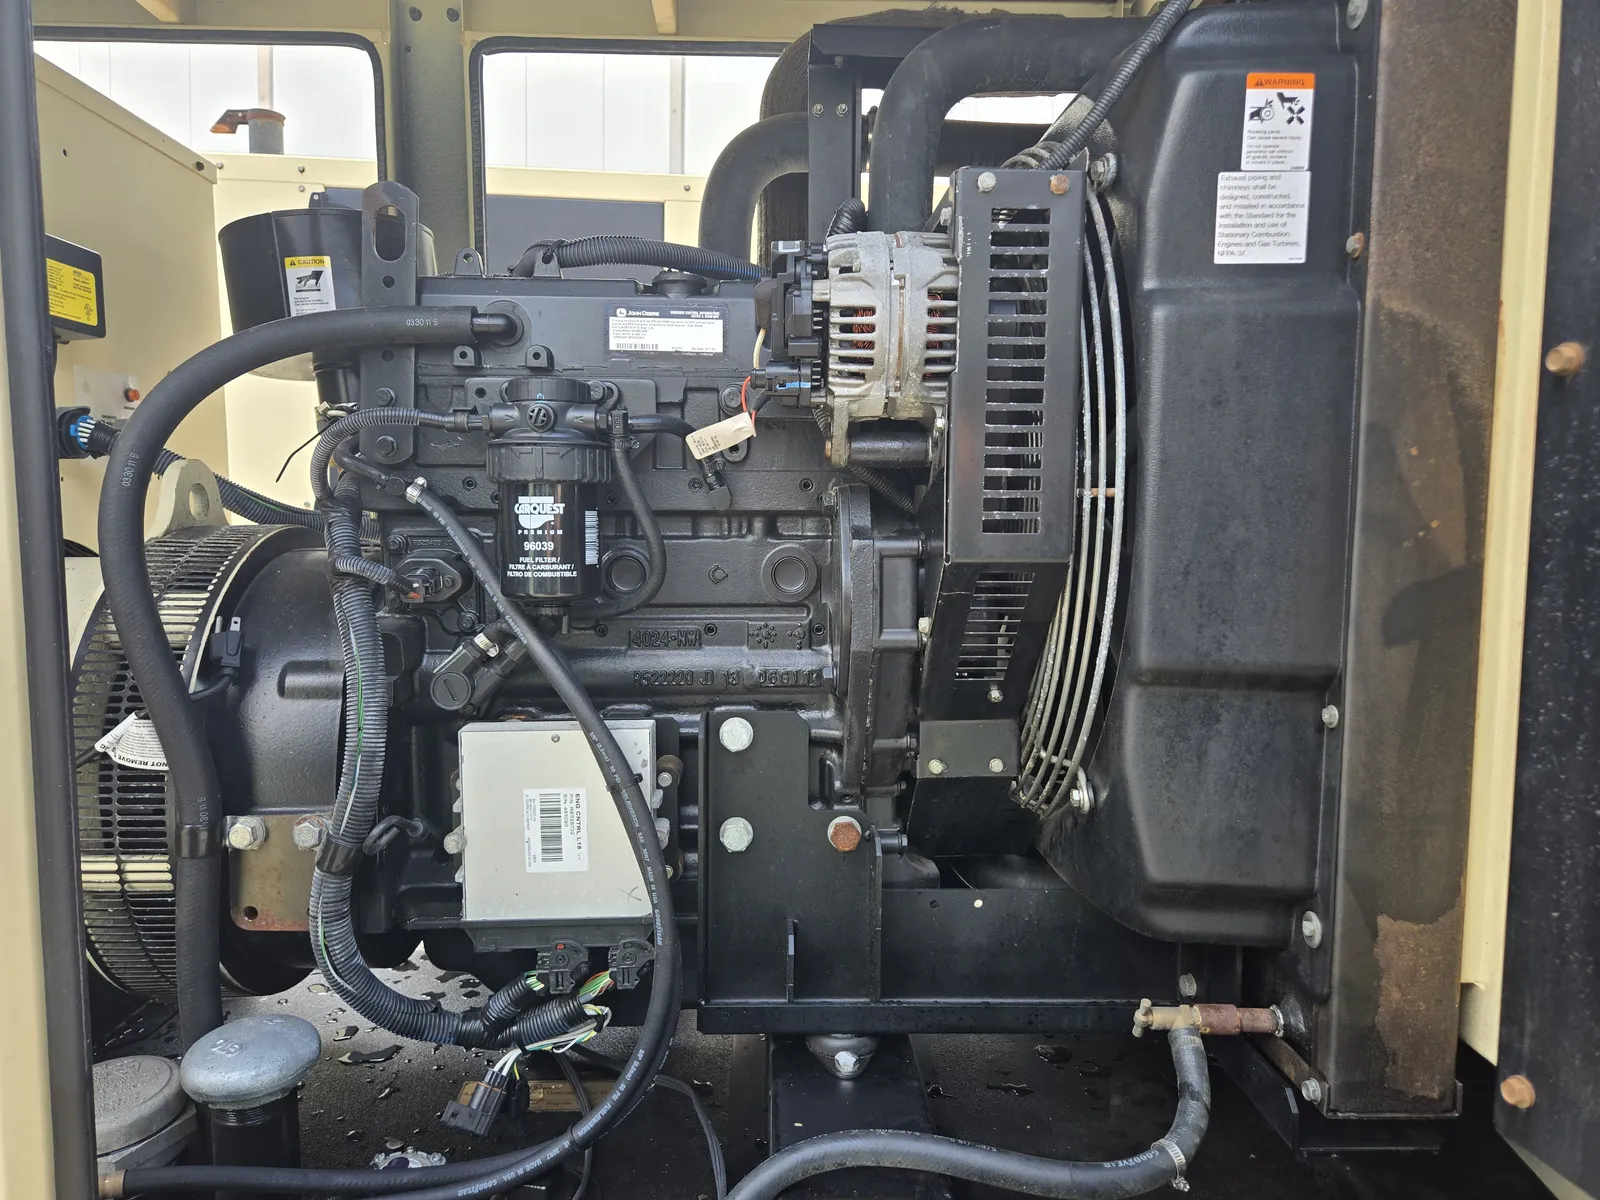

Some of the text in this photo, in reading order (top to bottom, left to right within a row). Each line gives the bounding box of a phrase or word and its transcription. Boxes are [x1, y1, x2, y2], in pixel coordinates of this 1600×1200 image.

[514, 503, 565, 515] CARQUEST
[524, 542, 554, 551] 96039
[496, 602, 504, 613] USA
[505, 615, 527, 645] GOODYEAR
[633, 670, 694, 686] R522220
[700, 670, 714, 686] JD
[723, 670, 739, 686] 13
[118, 754, 149, 766] REMOVE
[654, 909, 663, 946] GOODYEAR
[611, 1090, 621, 1101] PSI
[578, 1102, 612, 1137] FUEL/EMISSION
[526, 1159, 542, 1171] MADE
[1103, 1150, 1160, 1168] GOODYEAR
[503, 1172, 515, 1181] USA
[458, 1179, 497, 1196] GOODYEAR
